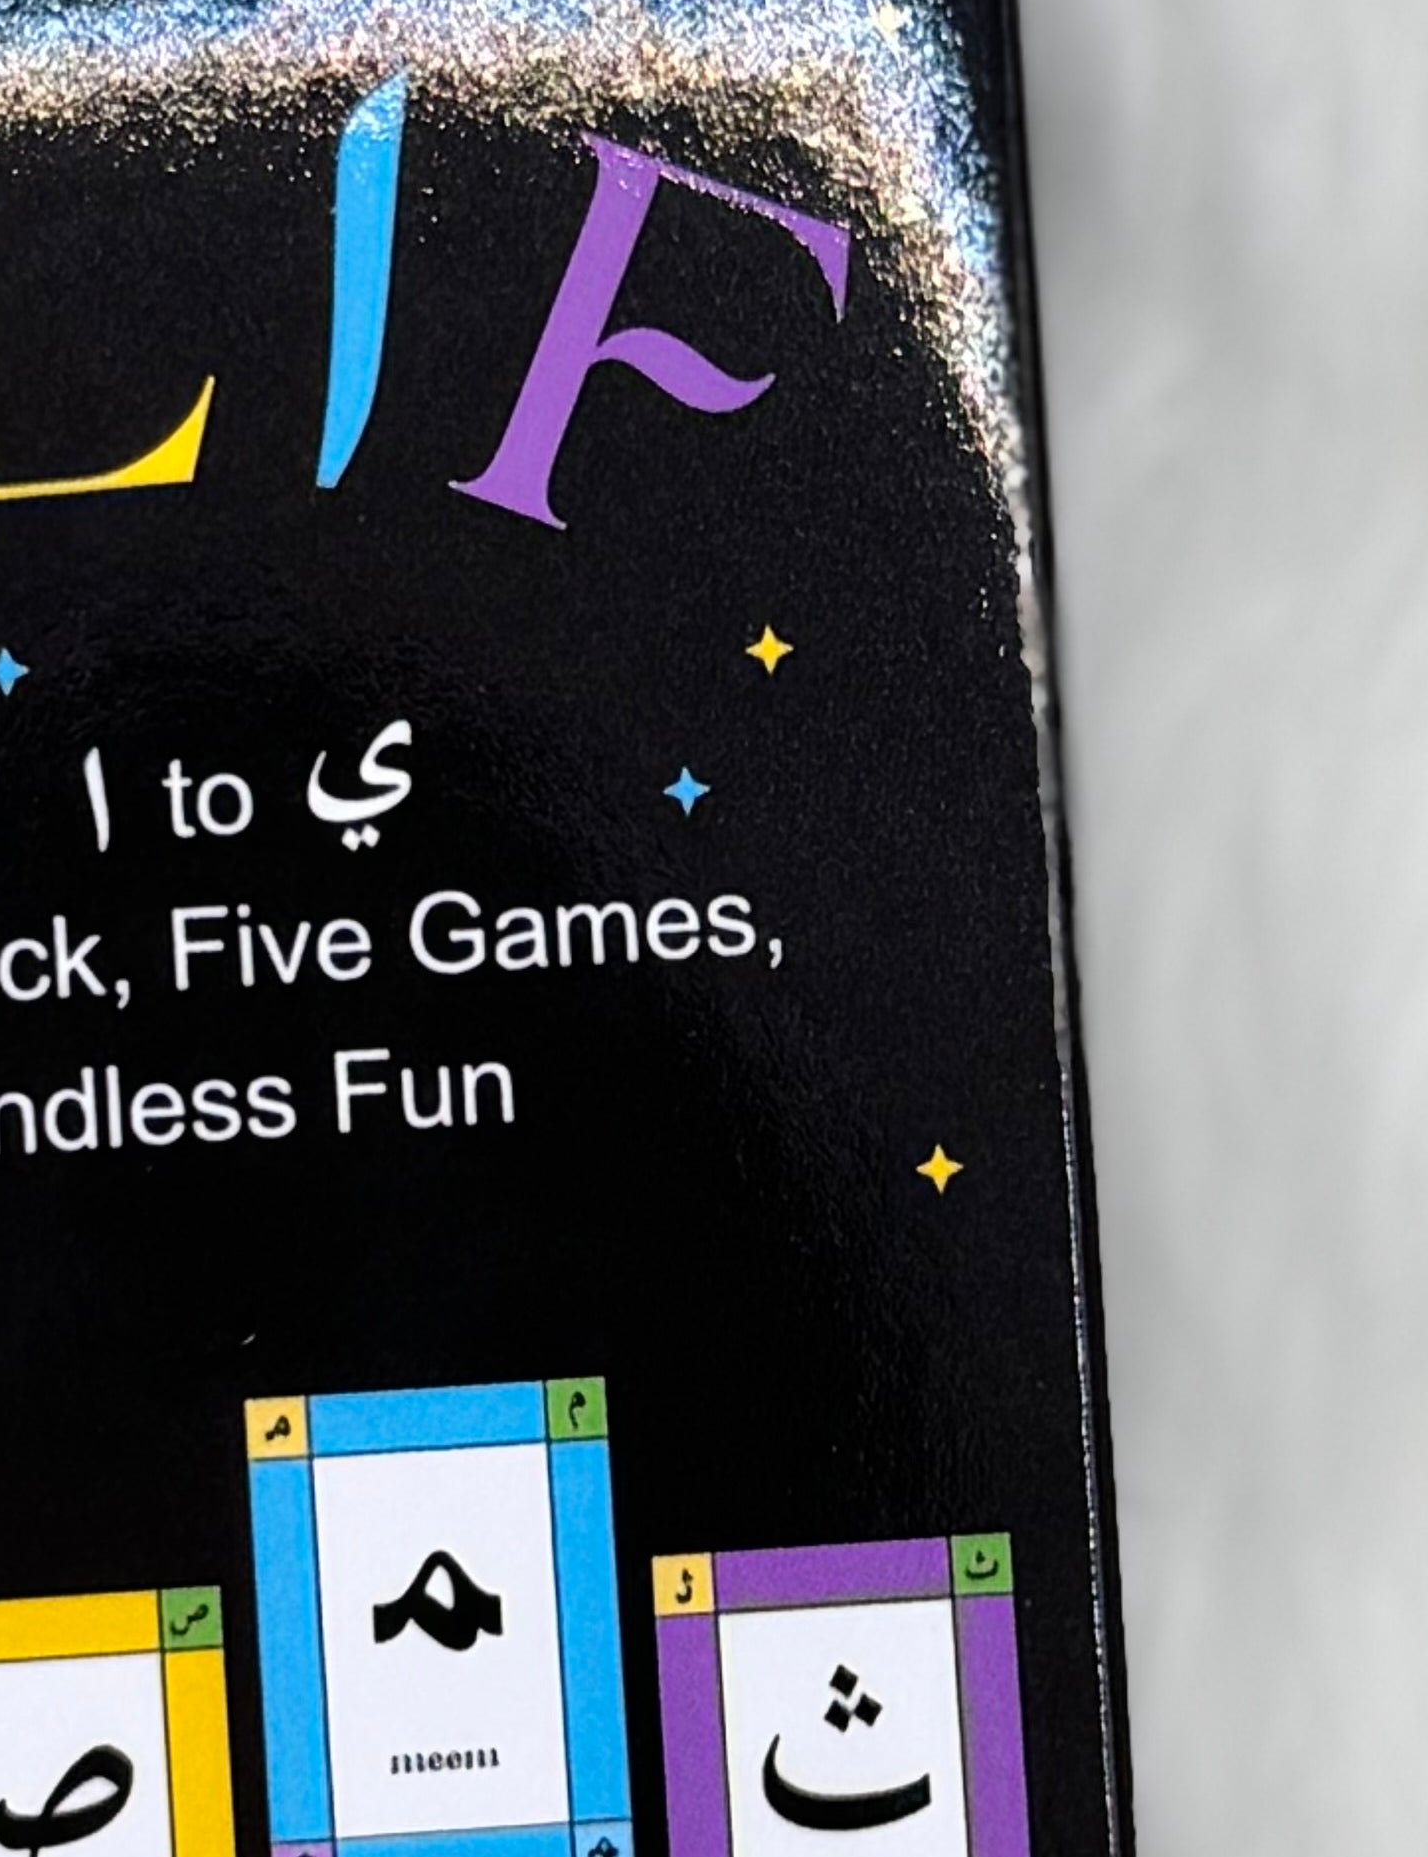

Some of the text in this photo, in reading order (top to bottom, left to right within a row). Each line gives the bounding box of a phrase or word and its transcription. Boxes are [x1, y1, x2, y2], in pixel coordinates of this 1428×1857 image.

[161, 759, 253, 839] to
[307, 719, 412, 851] ي
[171, 903, 372, 991] Five
[409, 890, 782, 974] Games,
[334, 1048, 515, 1134] Fun
[390, 1747, 500, 1775] meem
